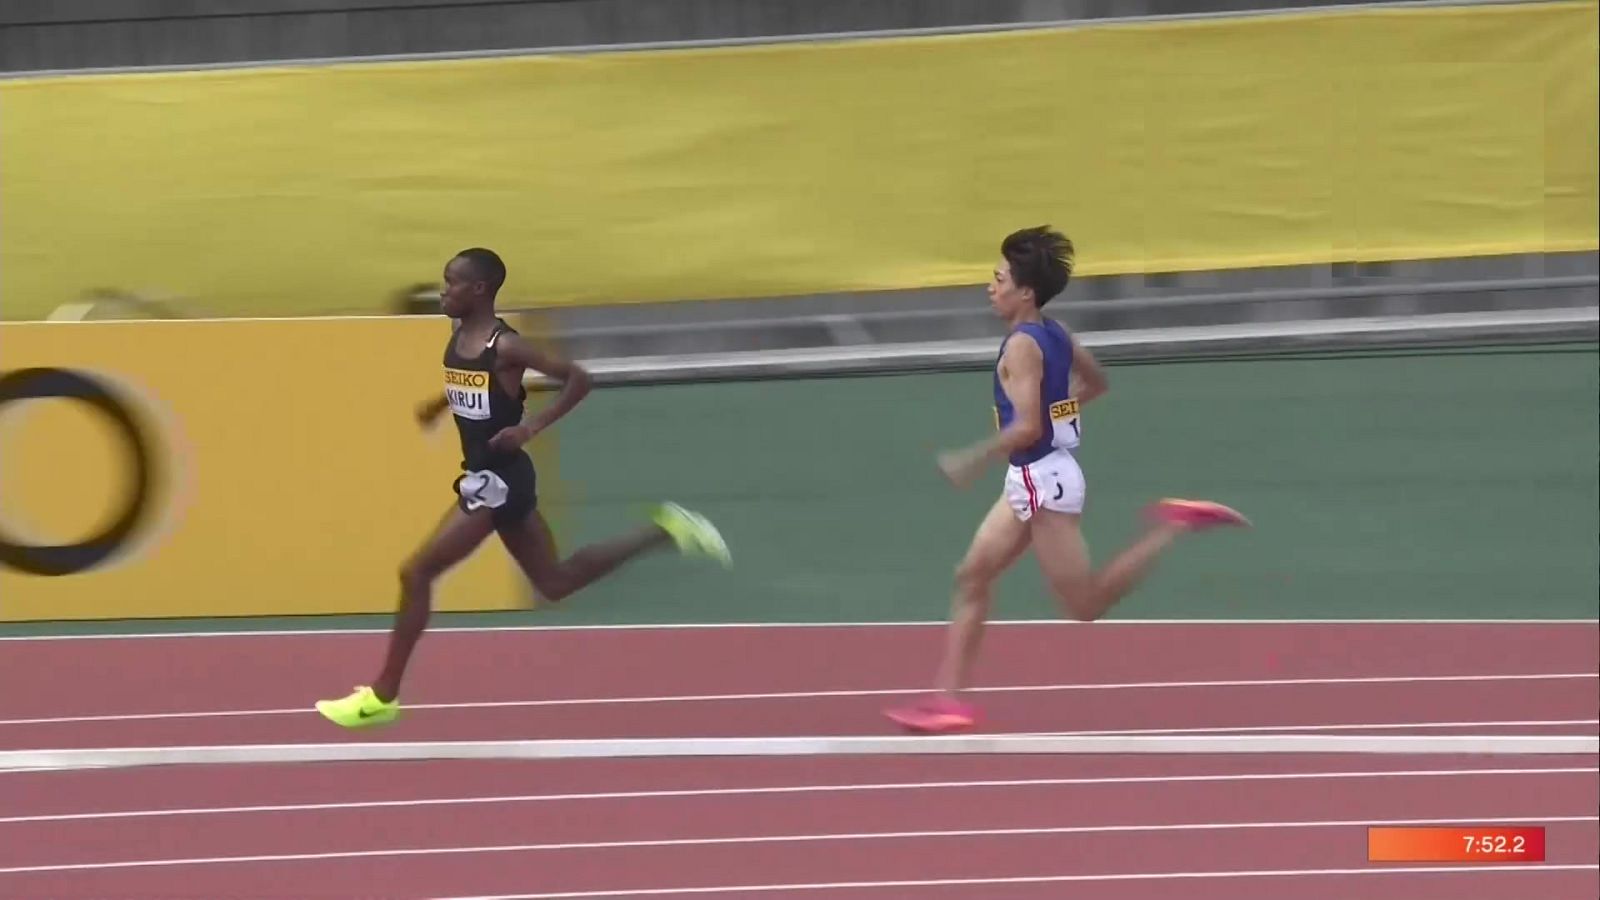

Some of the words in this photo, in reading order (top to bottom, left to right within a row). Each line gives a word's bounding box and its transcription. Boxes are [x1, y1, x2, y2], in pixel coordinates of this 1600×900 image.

[445, 371, 486, 387] SEIKO
[447, 388, 483, 410] KIRUI
[474, 474, 490, 501] 2
